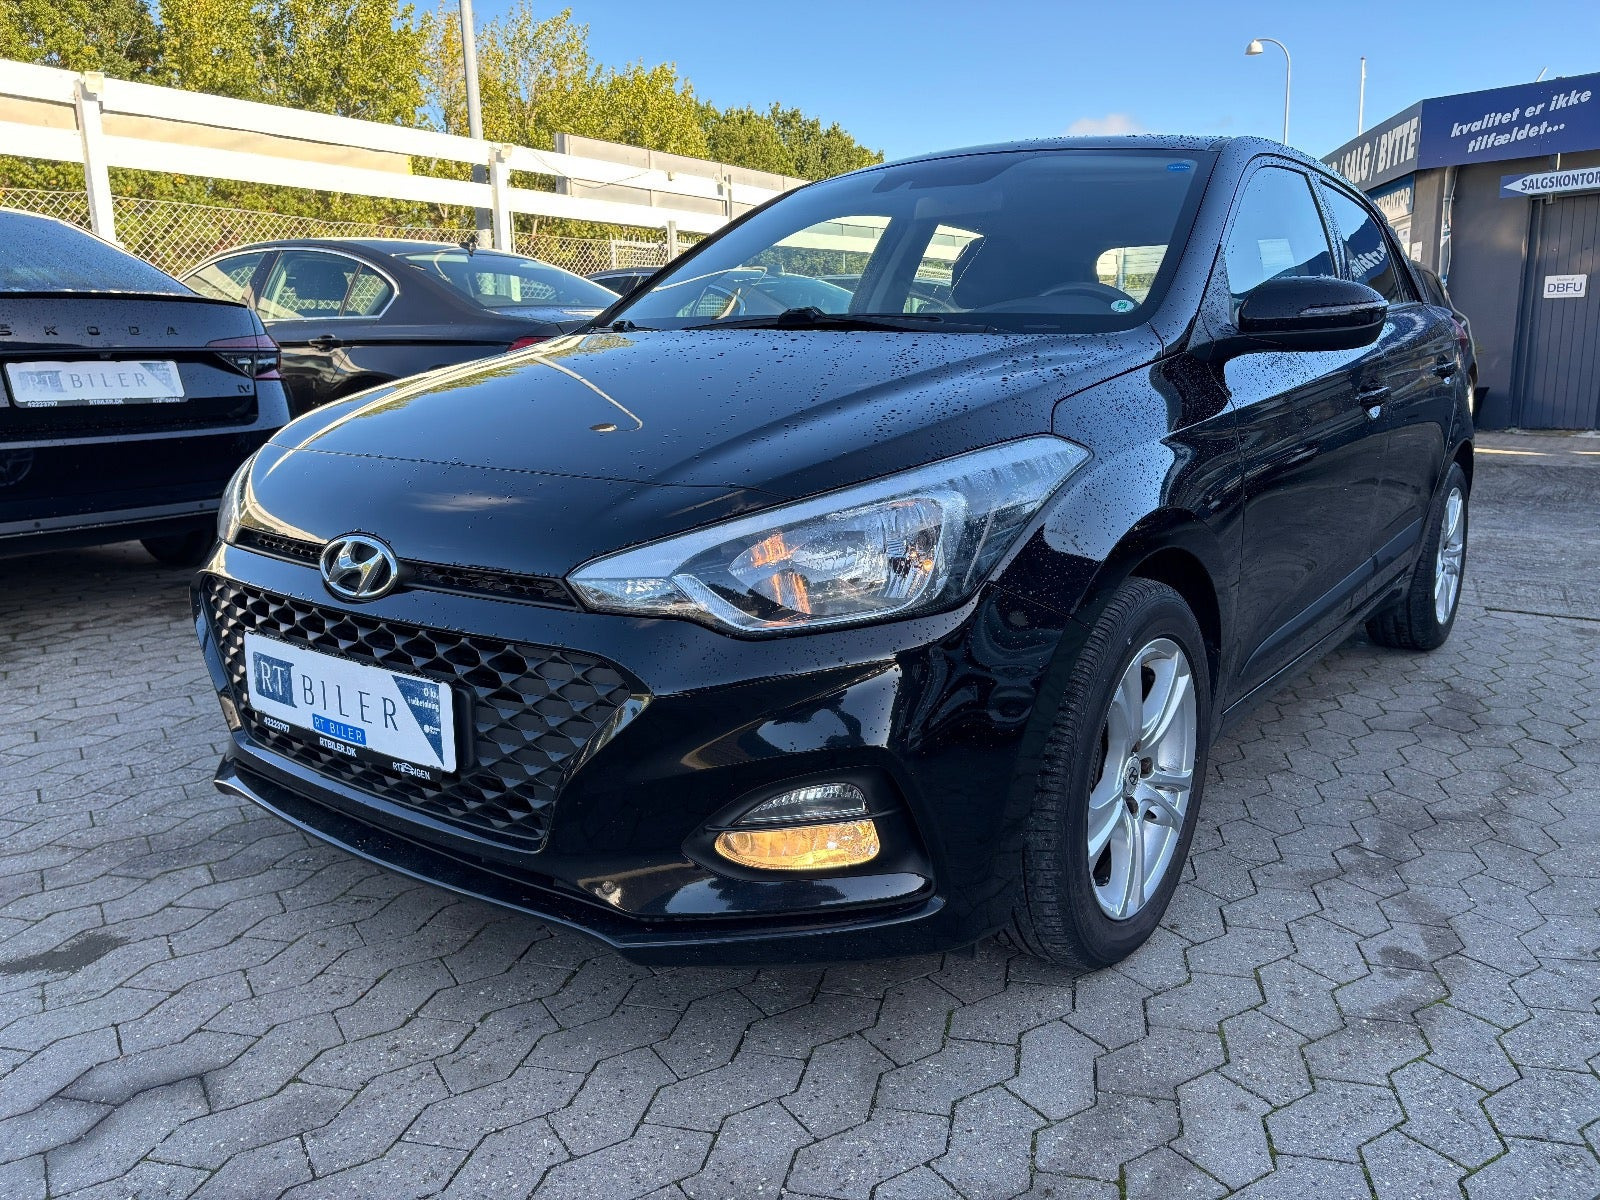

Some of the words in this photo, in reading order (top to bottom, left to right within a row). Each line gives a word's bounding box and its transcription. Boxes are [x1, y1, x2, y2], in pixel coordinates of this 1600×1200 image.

[1450, 107, 1520, 138] kvalitet
[1524, 102, 1545, 118] er
[1549, 89, 1592, 112] ikke
[1467, 121, 1566, 153] tilfældet...
[1344, 142, 1371, 184] SALG
[1377, 116, 1419, 174] BYTTE
[1520, 171, 1600, 191] SALGSKONTOR
[1547, 282, 1583, 293] DBFU
[70, 373, 148, 389] BILER
[260, 661, 285, 696] RT
[301, 674, 399, 731] BILER
[314, 717, 324, 730] RT
[329, 722, 363, 742] BILER
[319, 736, 357, 758] RTBILER.DK
